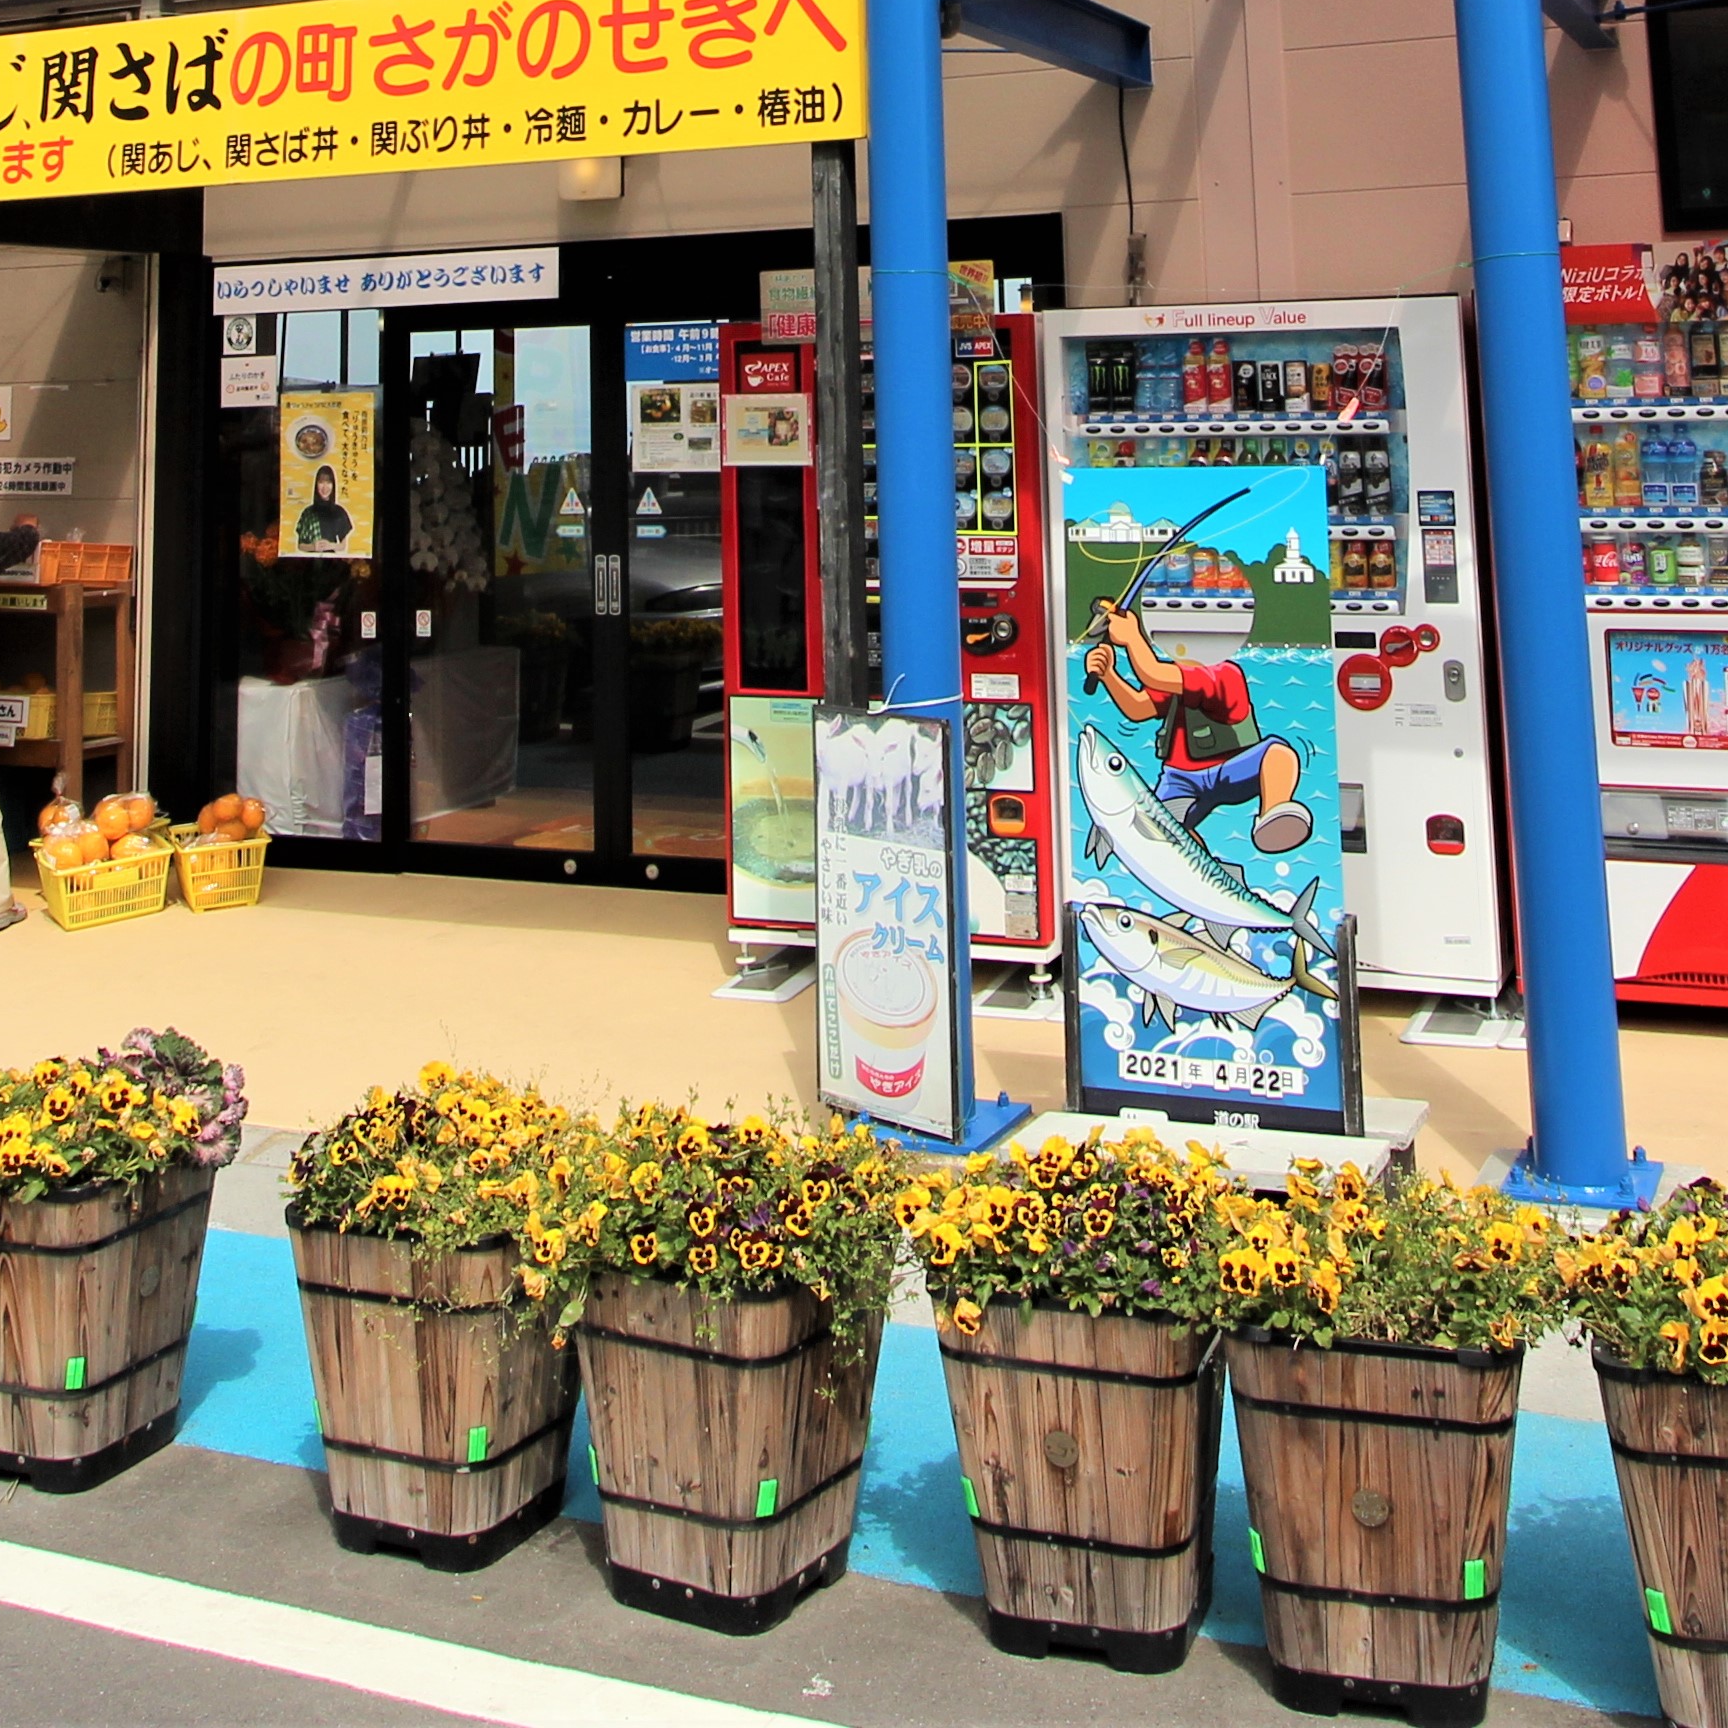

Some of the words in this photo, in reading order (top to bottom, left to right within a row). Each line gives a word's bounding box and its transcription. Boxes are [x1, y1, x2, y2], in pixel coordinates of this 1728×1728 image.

[360, 263, 545, 293] ありがとうございます
[1172, 310, 1202, 328] Full
[1208, 312, 1255, 330] lineup
[1259, 307, 1307, 325] Value
[630, 328, 674, 343] 営業時間
[760, 362, 790, 373] APEX
[766, 373, 790, 382] Cafe
[970, 539, 996, 554] 増量
[833, 797, 848, 926] 母乳に一番近い
[879, 849, 943, 879] やぎ乳の
[820, 838, 833, 924] やさしい味
[852, 871, 945, 929] アイス
[872, 922, 945, 964] クリーム
[870, 1069, 921, 1093] やぎアイス
[1214, 1110, 1260, 1130] 道の駅
